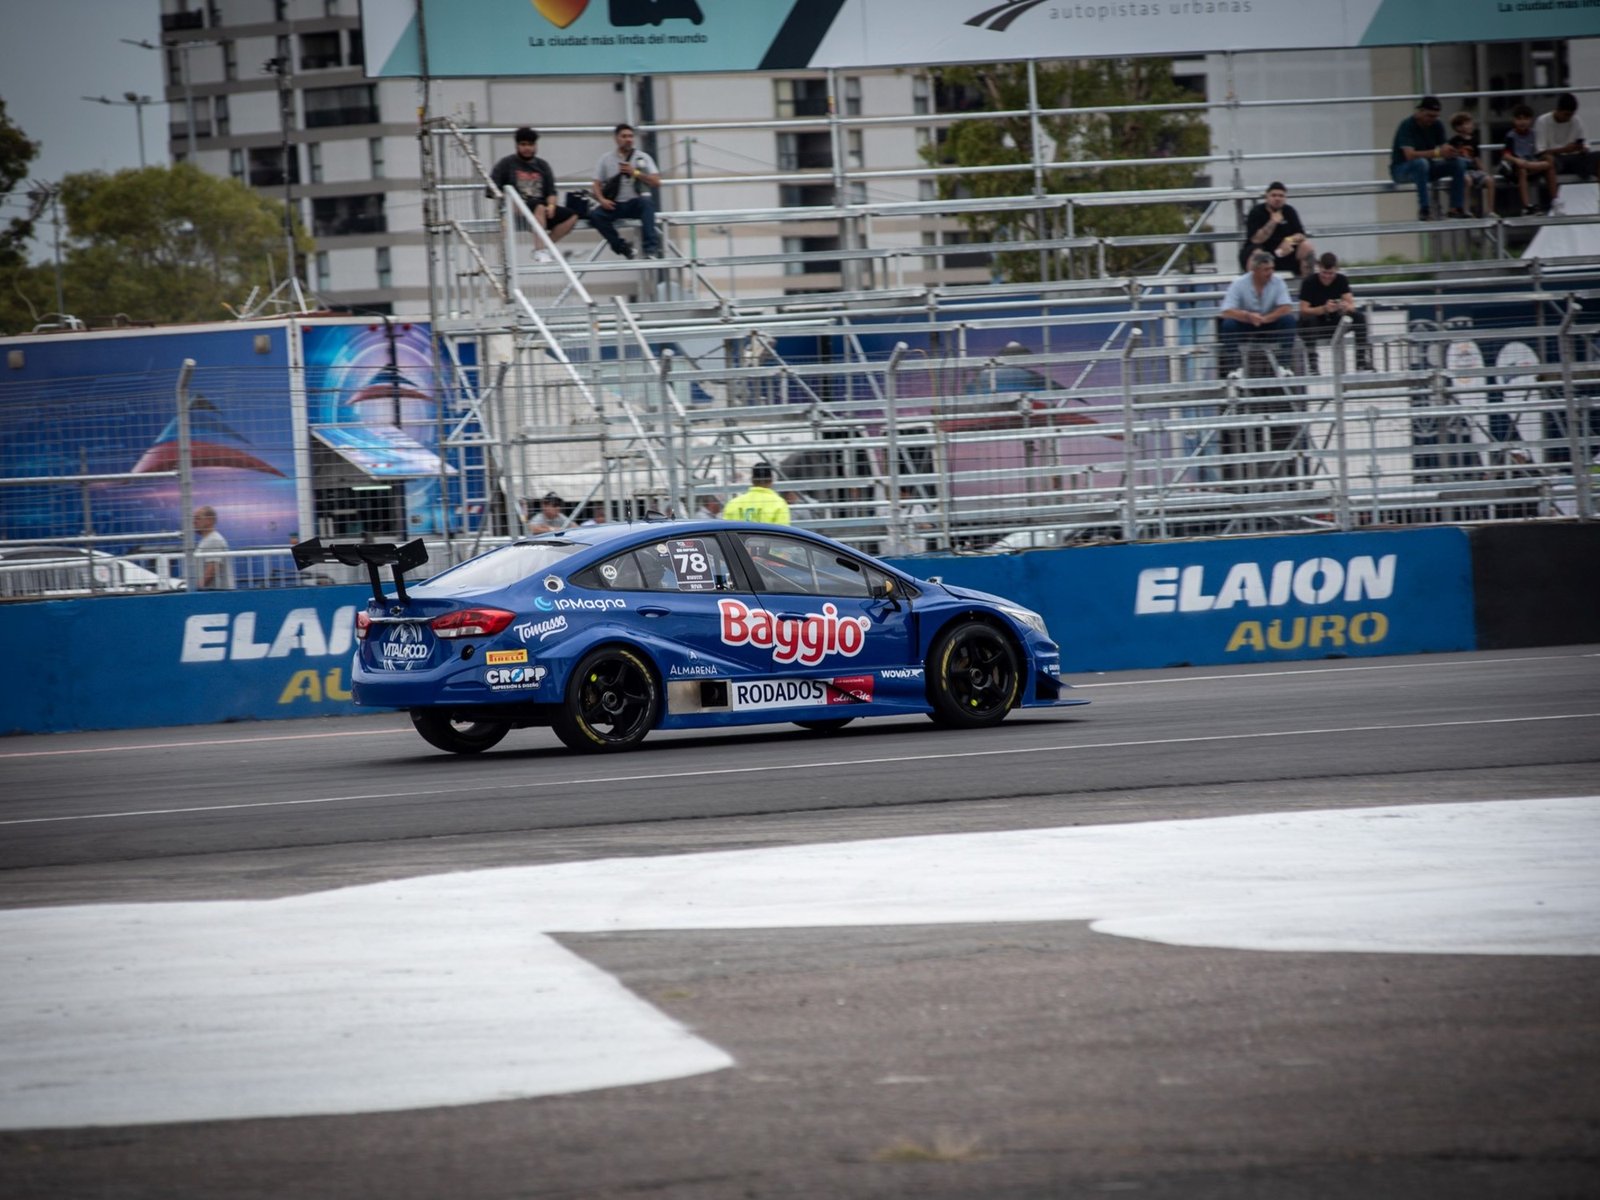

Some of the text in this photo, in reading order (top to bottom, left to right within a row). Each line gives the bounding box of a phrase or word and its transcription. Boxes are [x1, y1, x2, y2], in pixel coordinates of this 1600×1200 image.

[1049, 0, 1252, 21] autopistas urbanas
[529, 33, 708, 47] La ciudad más linda del mundo
[673, 552, 708, 574] 78
[1134, 554, 1398, 615] ELAION
[554, 598, 627, 612] IPMagna
[180, 605, 358, 663] ELAI
[513, 615, 568, 643] Tomasso
[719, 600, 864, 666] Baggio
[1224, 611, 1389, 652] AURO
[486, 667, 546, 684] CROPP
[670, 664, 718, 676] ALMARENA
[278, 668, 353, 704] AU
[737, 681, 825, 705] RODADOS
